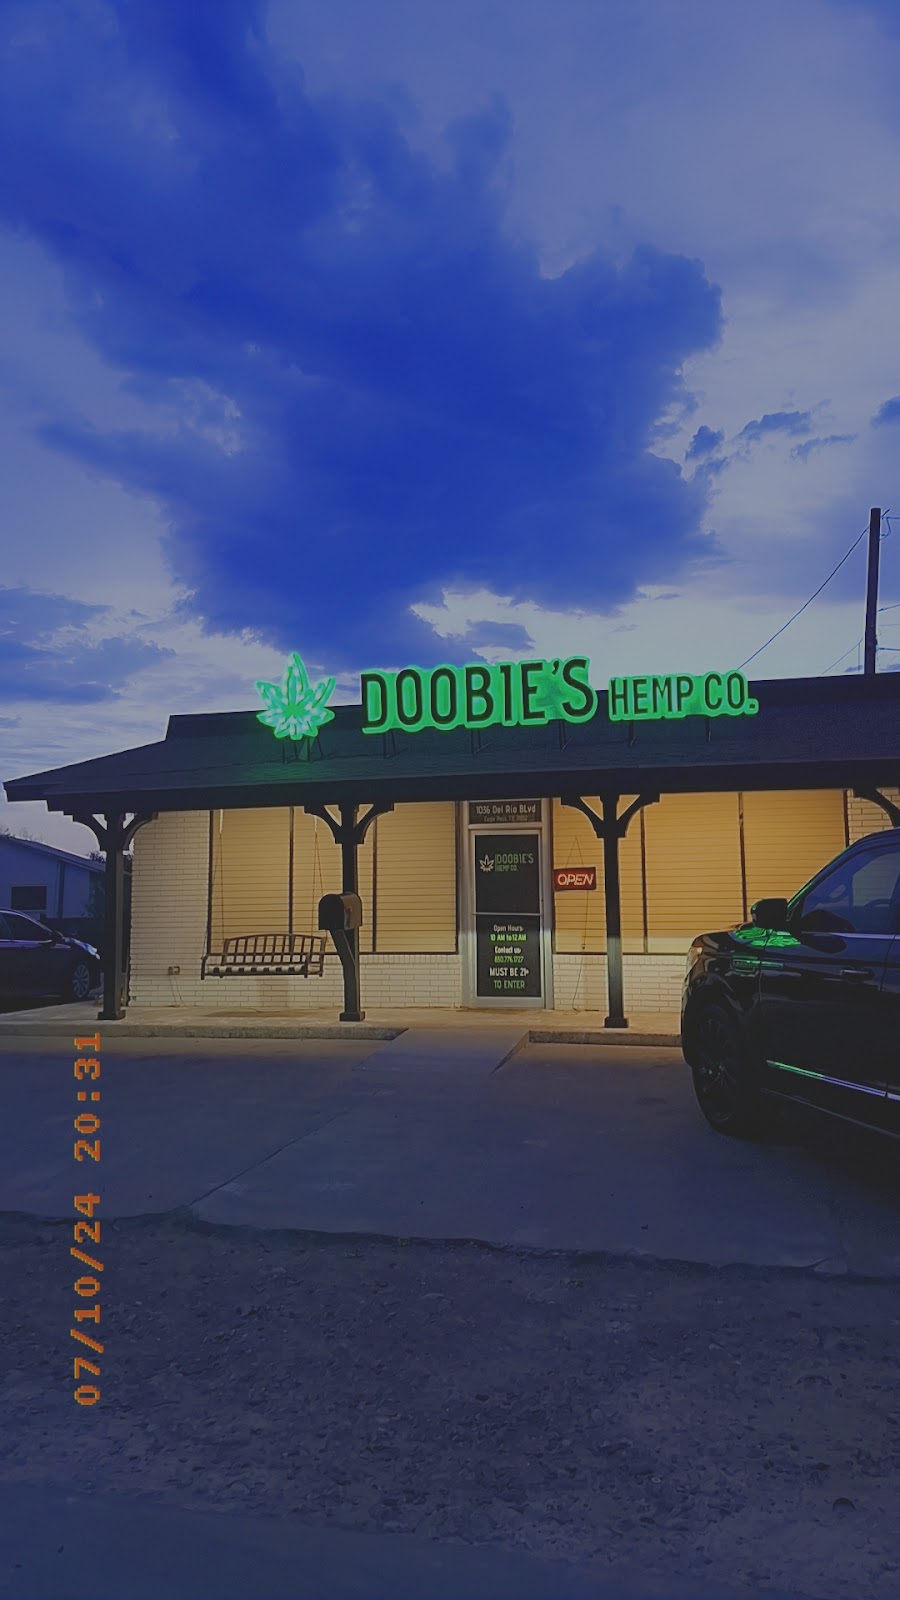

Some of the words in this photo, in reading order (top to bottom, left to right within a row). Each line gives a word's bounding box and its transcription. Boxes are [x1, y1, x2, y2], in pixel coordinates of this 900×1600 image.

[360, 657, 594, 729] DOOBIE'S
[610, 675, 693, 716] HEMP
[703, 669, 758, 712] CO.
[476, 806, 490, 814] 1036
[493, 805, 503, 814] Del
[505, 805, 517, 814] Rio
[496, 853, 534, 864] DOOBIE'S
[557, 873, 594, 886] OPEN
[493, 924, 506, 933] Open
[490, 933, 496, 941] 10
[497, 933, 505, 941] AM
[512, 933, 518, 941] 12
[518, 933, 527, 941] AM
[494, 945, 513, 954] Contact
[489, 967, 508, 977] MUST
[509, 967, 518, 976] BE
[519, 967, 530, 976] 21+
[493, 980, 502, 989] TO
[503, 979, 526, 989] ENTER
